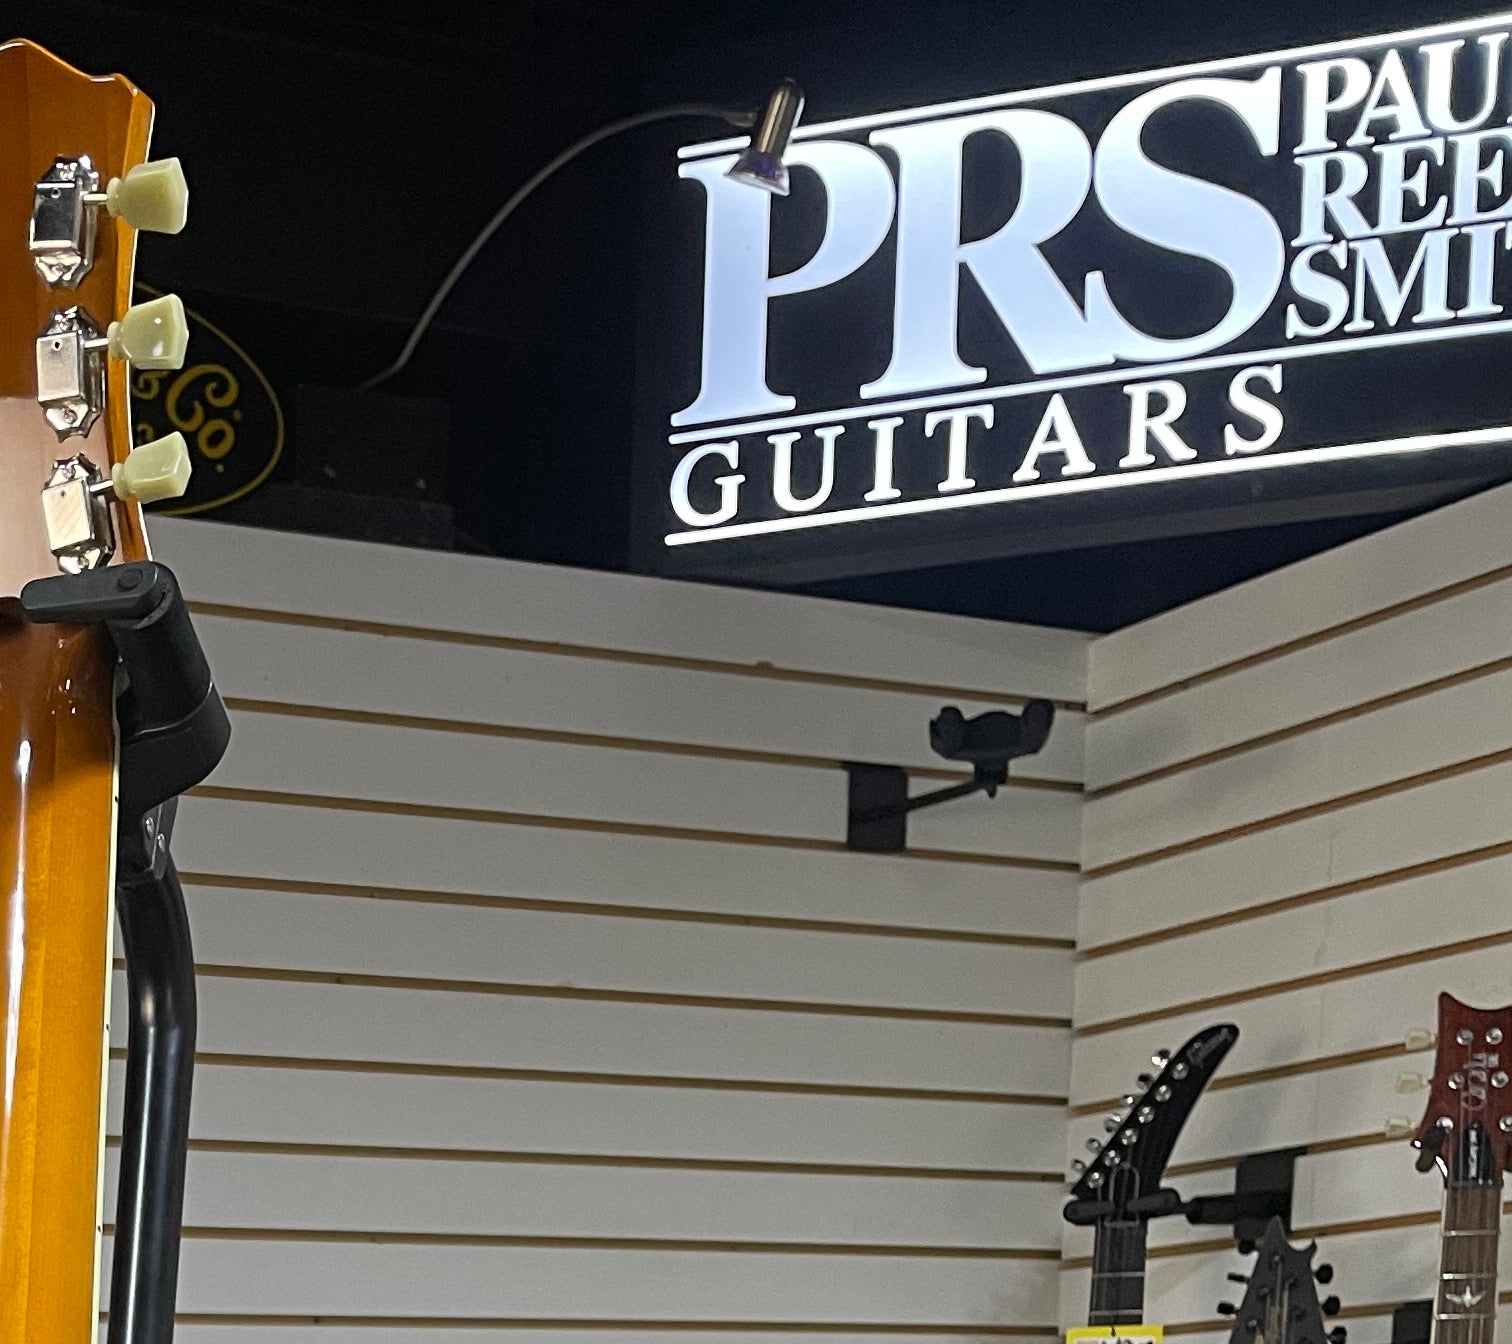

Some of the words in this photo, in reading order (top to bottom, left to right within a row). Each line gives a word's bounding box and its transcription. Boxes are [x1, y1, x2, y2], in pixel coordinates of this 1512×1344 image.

[1294, 32, 1512, 154] PAU
[670, 66, 1282, 427] PRS
[1286, 219, 1512, 338] SMI
[669, 362, 1285, 527] GUITARS
